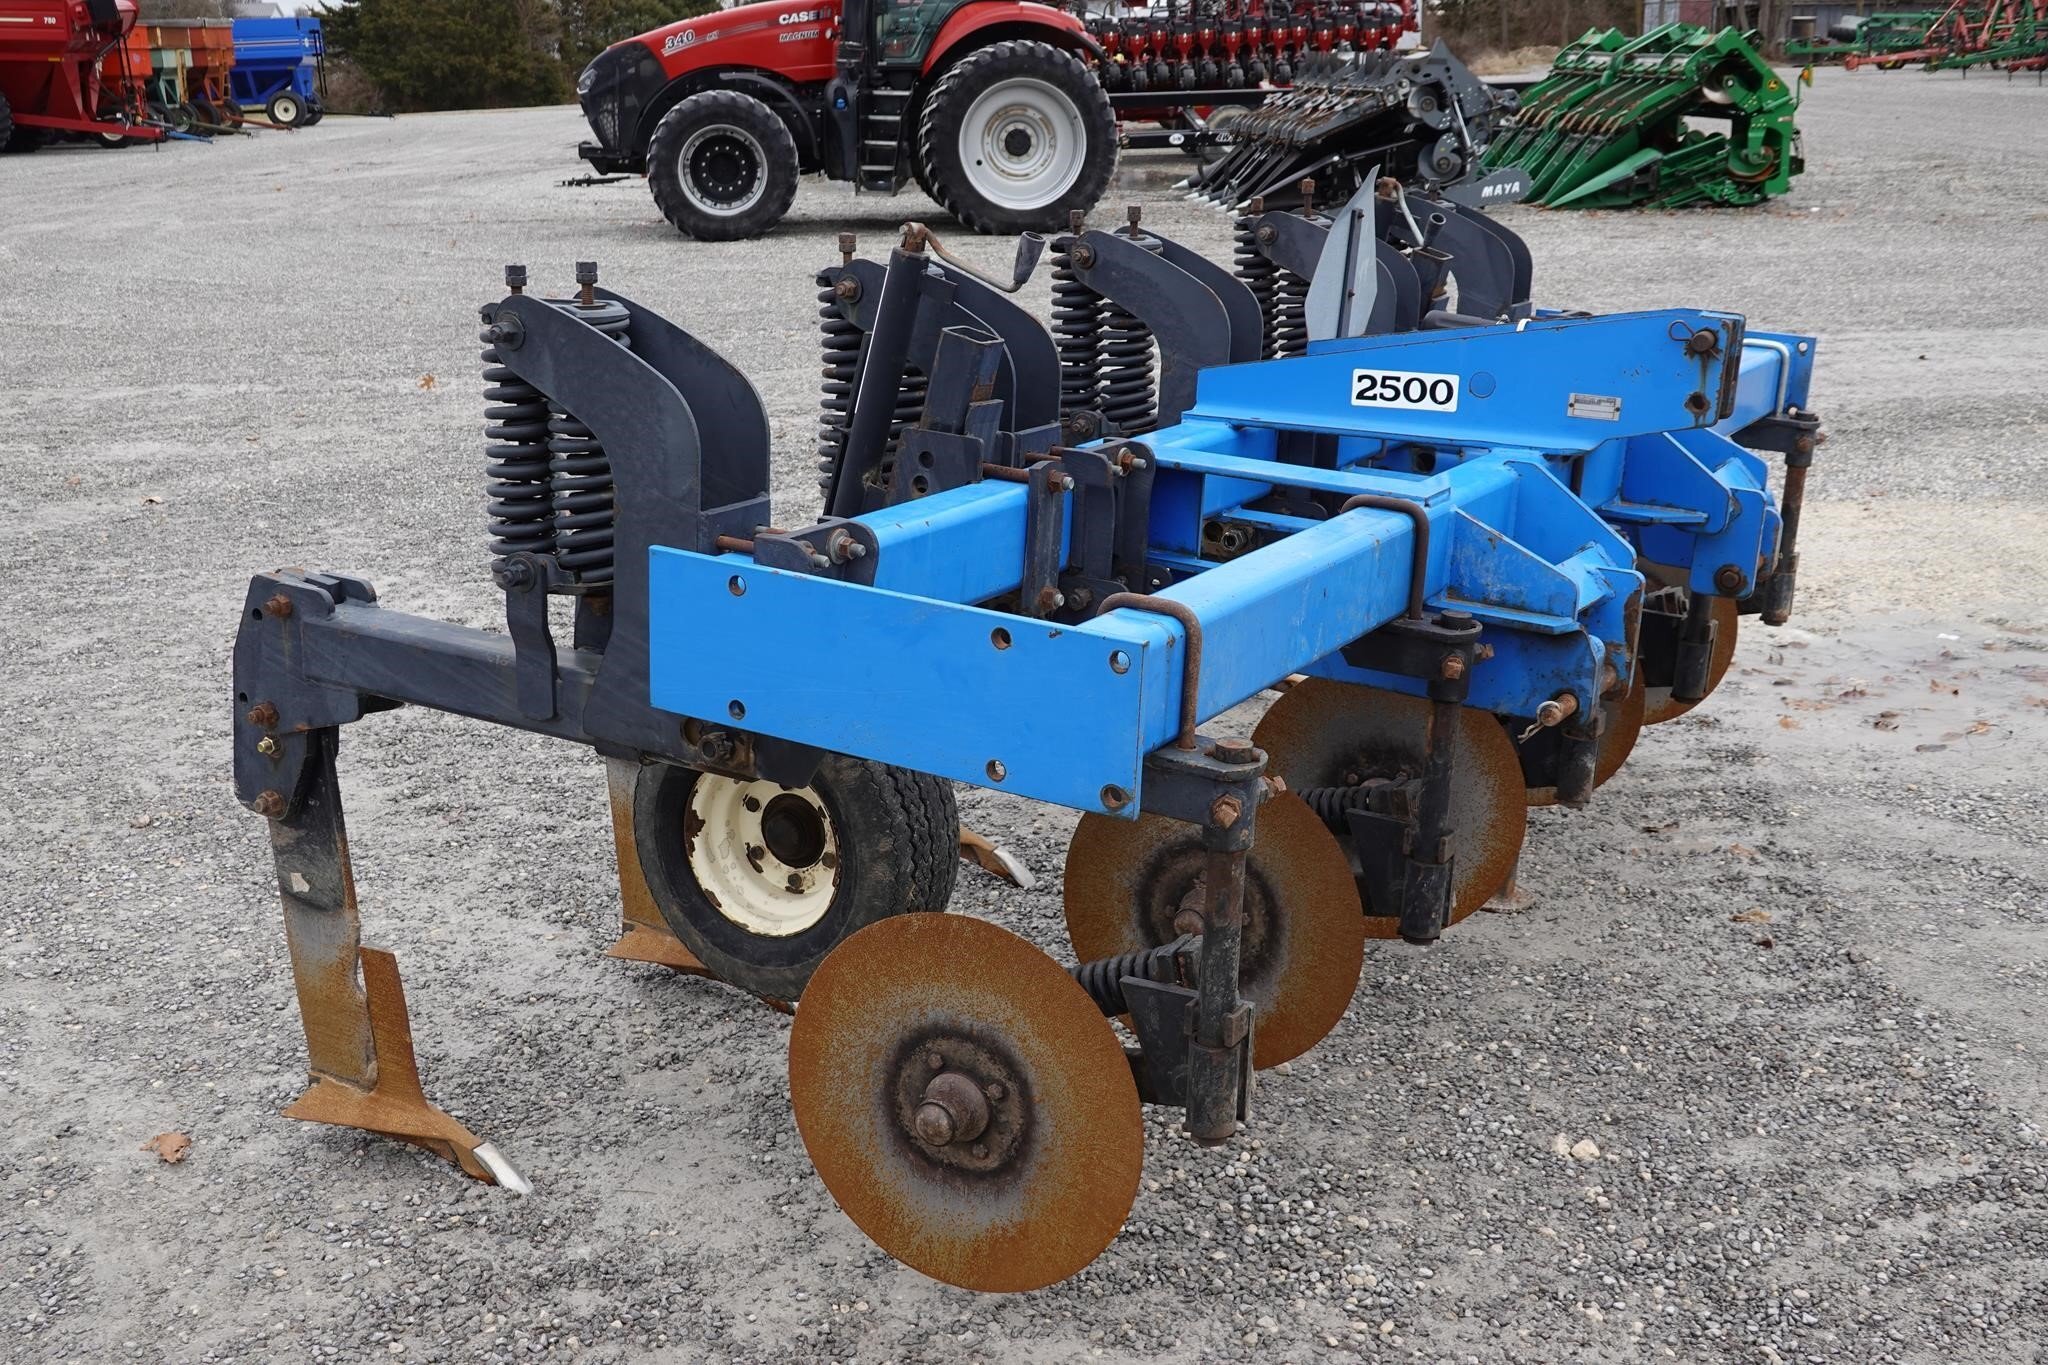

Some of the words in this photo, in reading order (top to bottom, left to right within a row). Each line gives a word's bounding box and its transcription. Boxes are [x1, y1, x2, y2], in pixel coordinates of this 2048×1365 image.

[779, 10, 818, 25] CASE
[665, 29, 695, 49] 340
[779, 30, 819, 43] MAGNUM
[1481, 181, 1520, 198] MAYA
[1355, 374, 1454, 406] 2500
